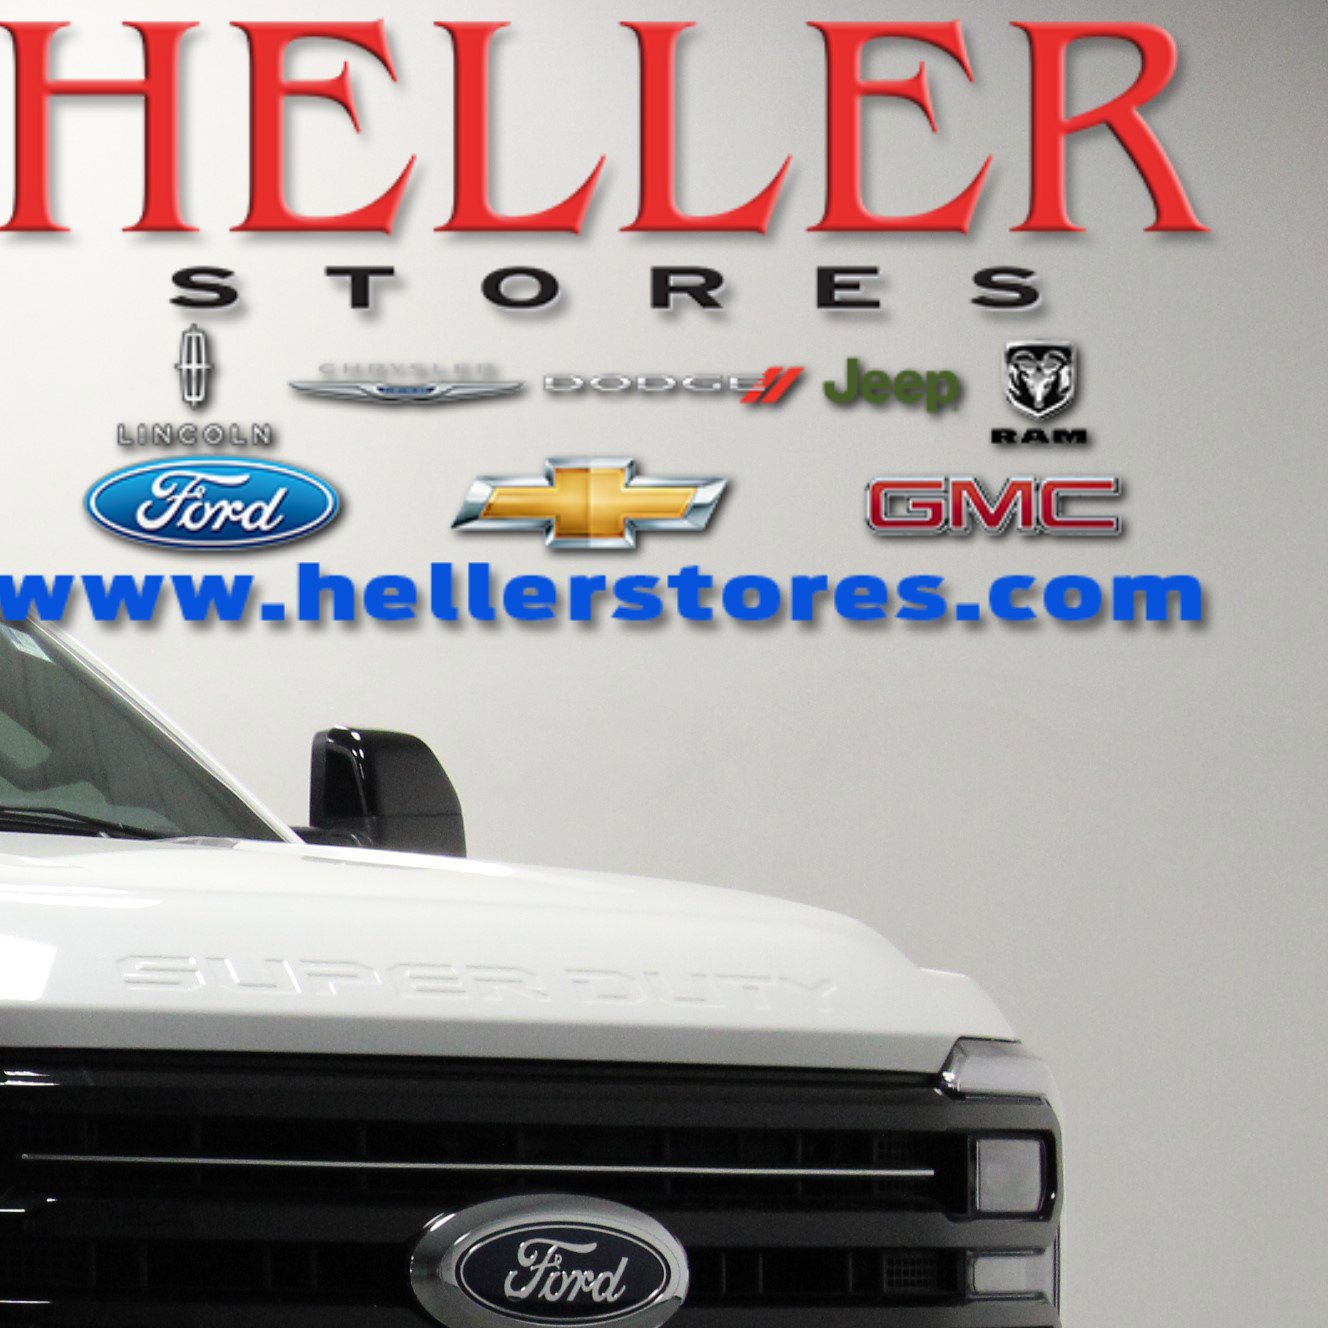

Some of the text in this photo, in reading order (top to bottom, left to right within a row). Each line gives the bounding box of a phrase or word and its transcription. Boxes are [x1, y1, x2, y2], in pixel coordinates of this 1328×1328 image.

[116, 954, 839, 1012] SUPER DUTY
[504, 1238, 628, 1301] Ford
